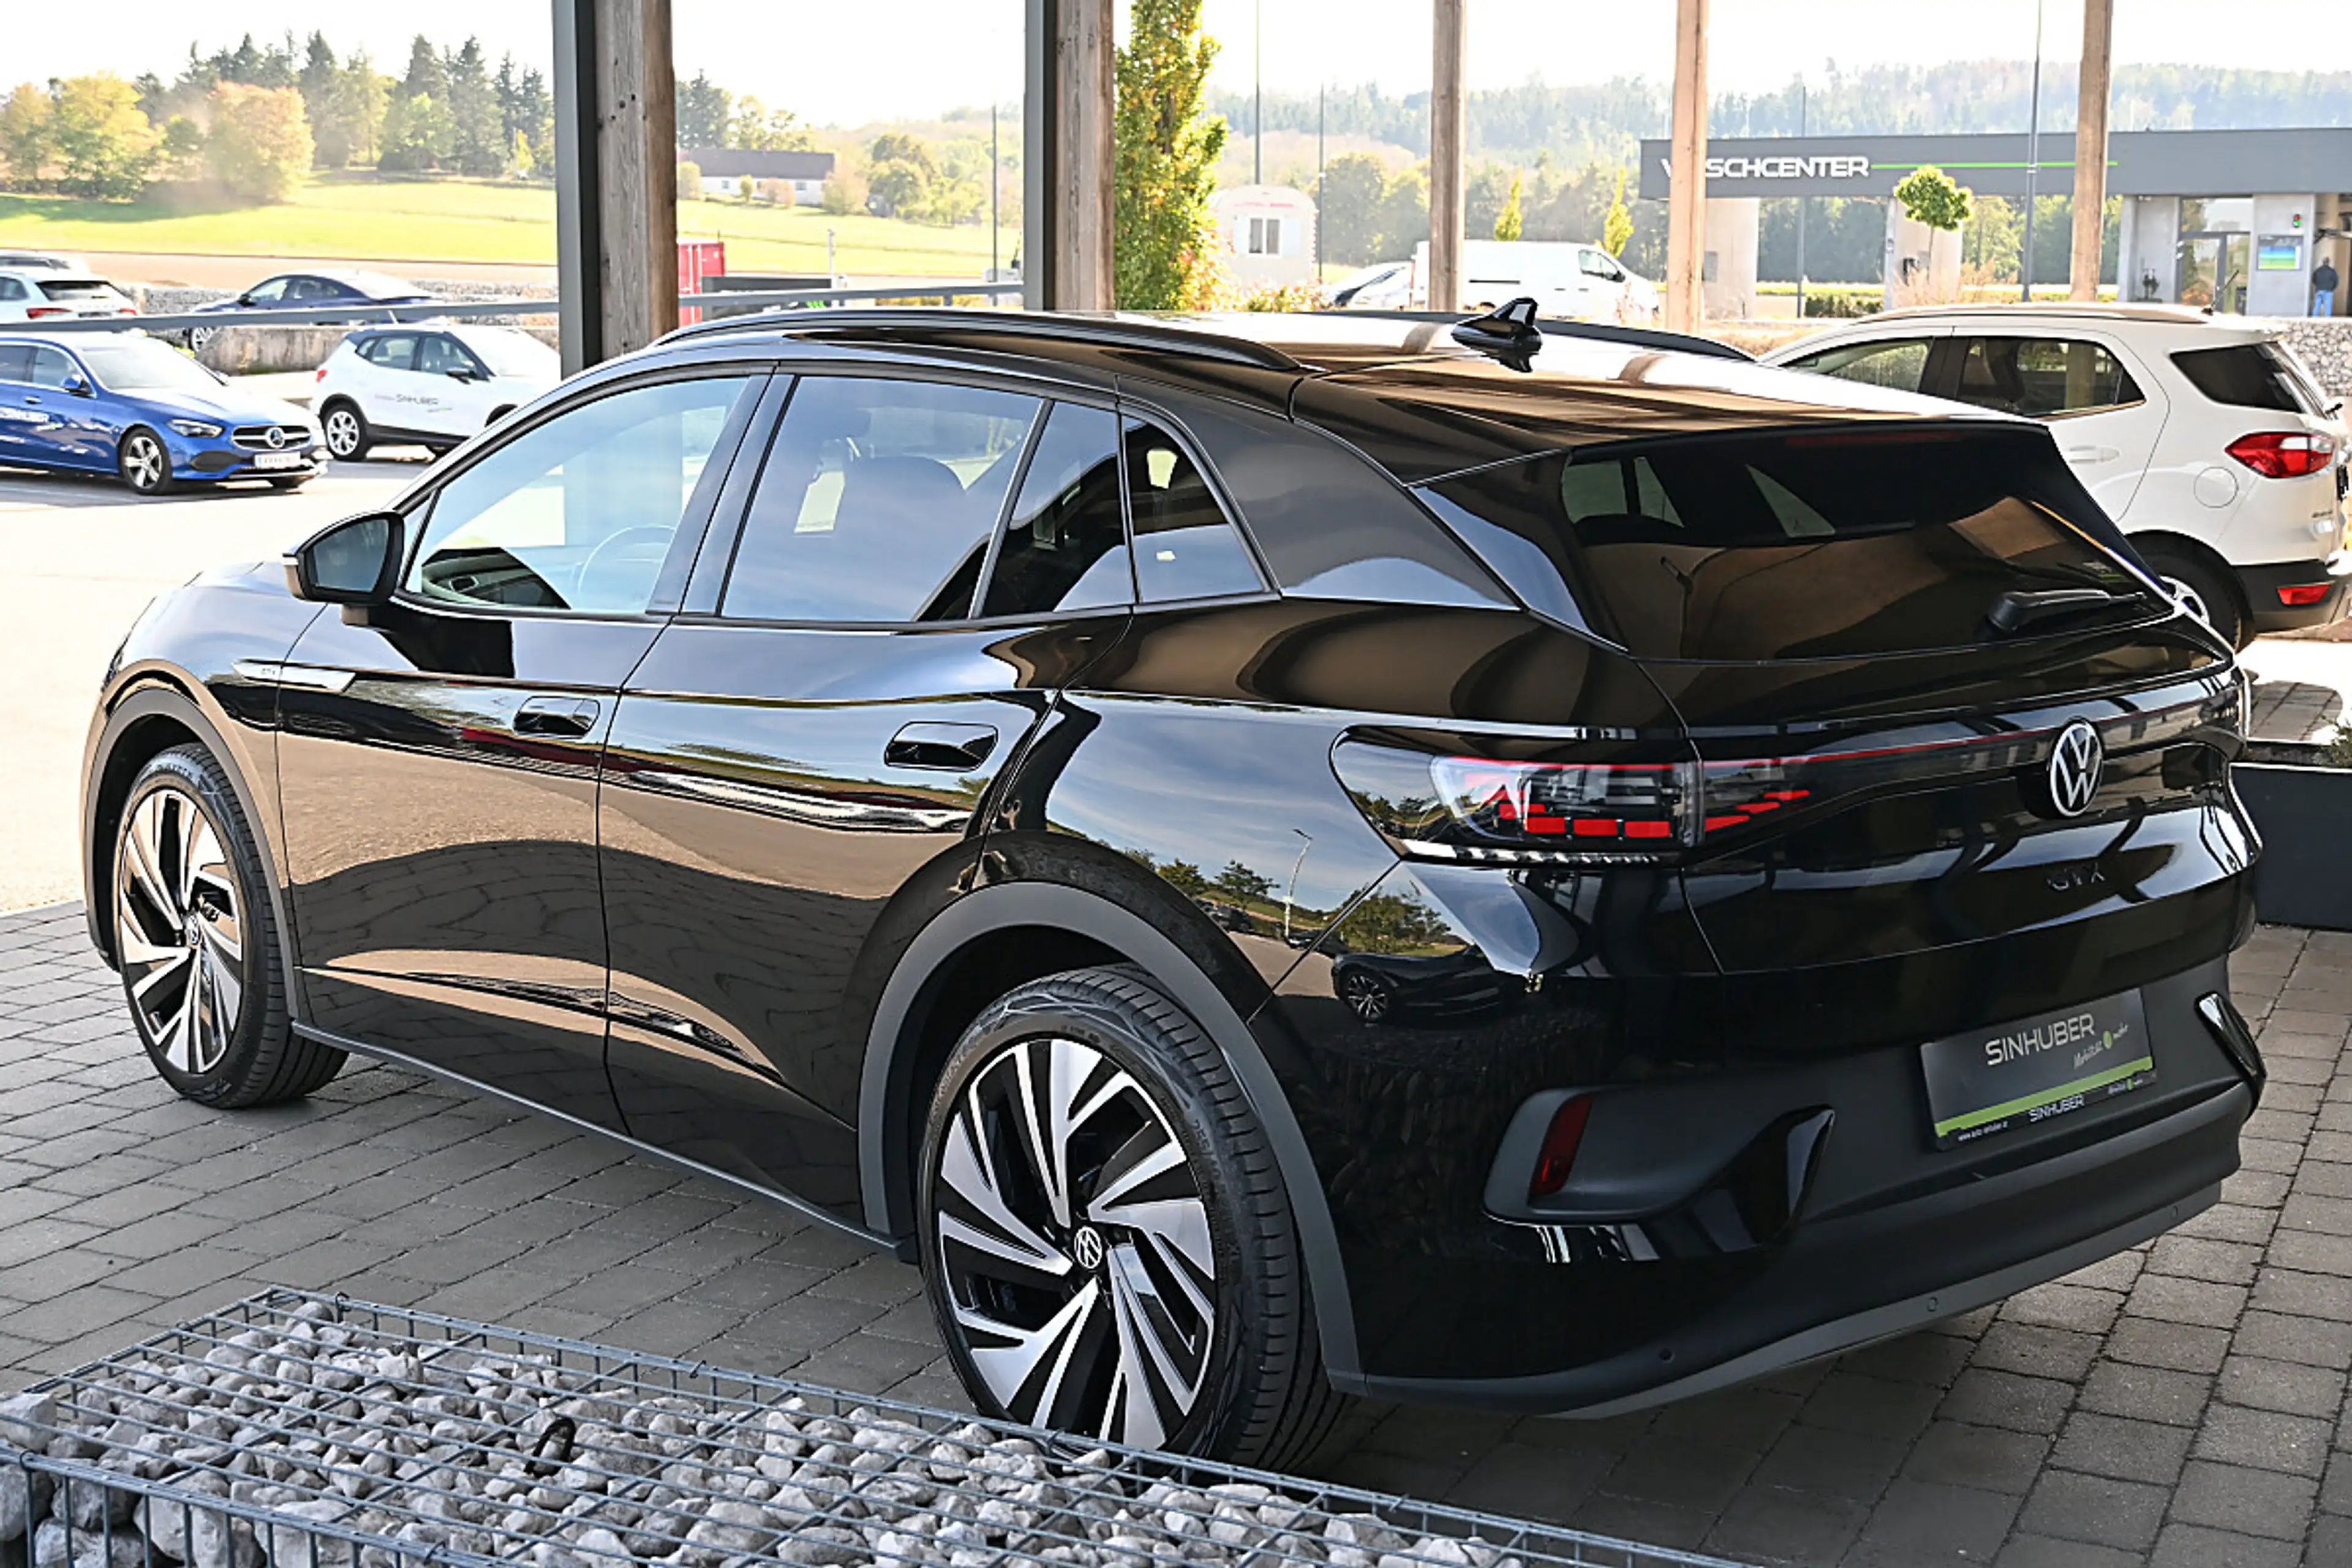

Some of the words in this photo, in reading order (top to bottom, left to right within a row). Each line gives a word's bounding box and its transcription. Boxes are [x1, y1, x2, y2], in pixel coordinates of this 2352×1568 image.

[1660, 157, 1869, 178] SCHCENTER
[1985, 1013, 2095, 1066] SINHUBER
[2028, 1095, 2084, 1122] SINHUBER
